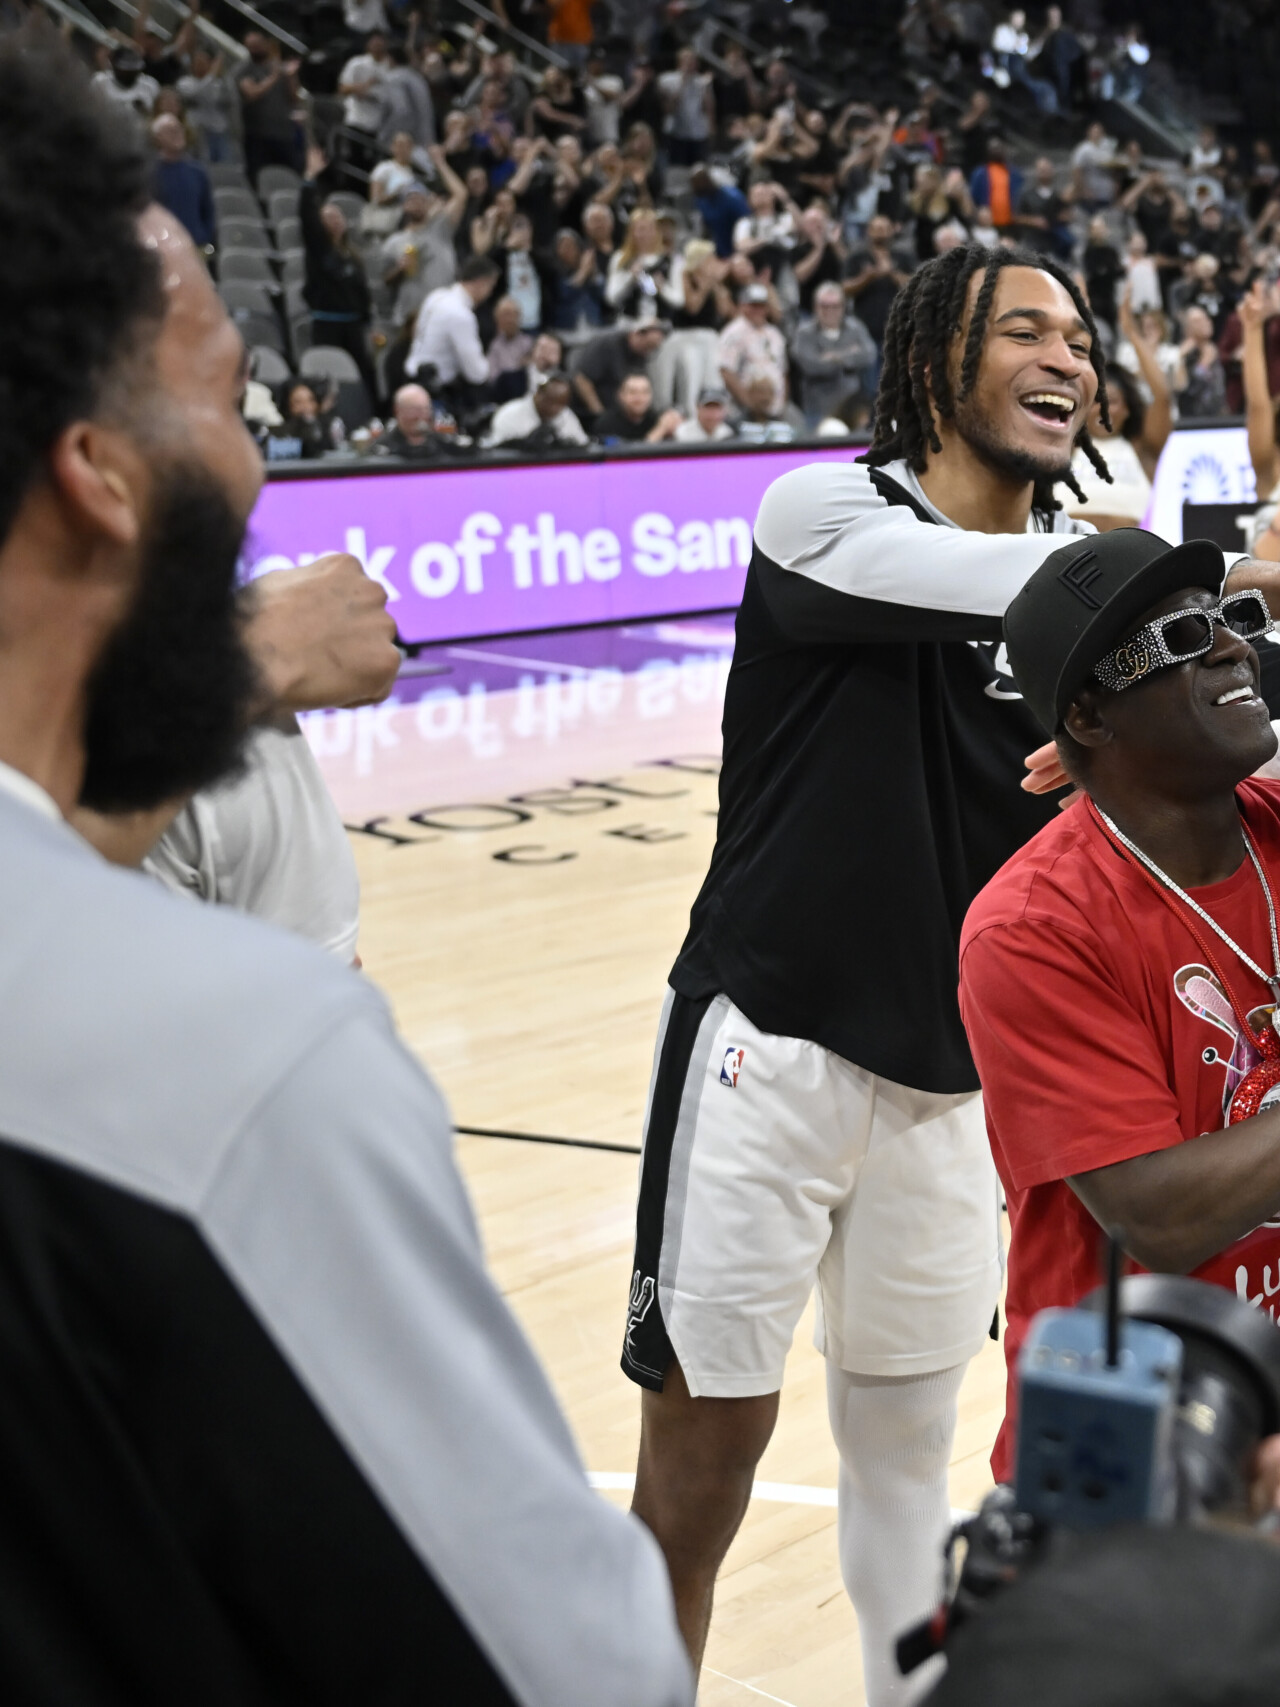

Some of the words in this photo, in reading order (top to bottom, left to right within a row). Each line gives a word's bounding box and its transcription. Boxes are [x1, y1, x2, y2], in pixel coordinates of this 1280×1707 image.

[410, 511, 502, 599] of
[506, 512, 622, 590] the
[631, 512, 753, 578] San
